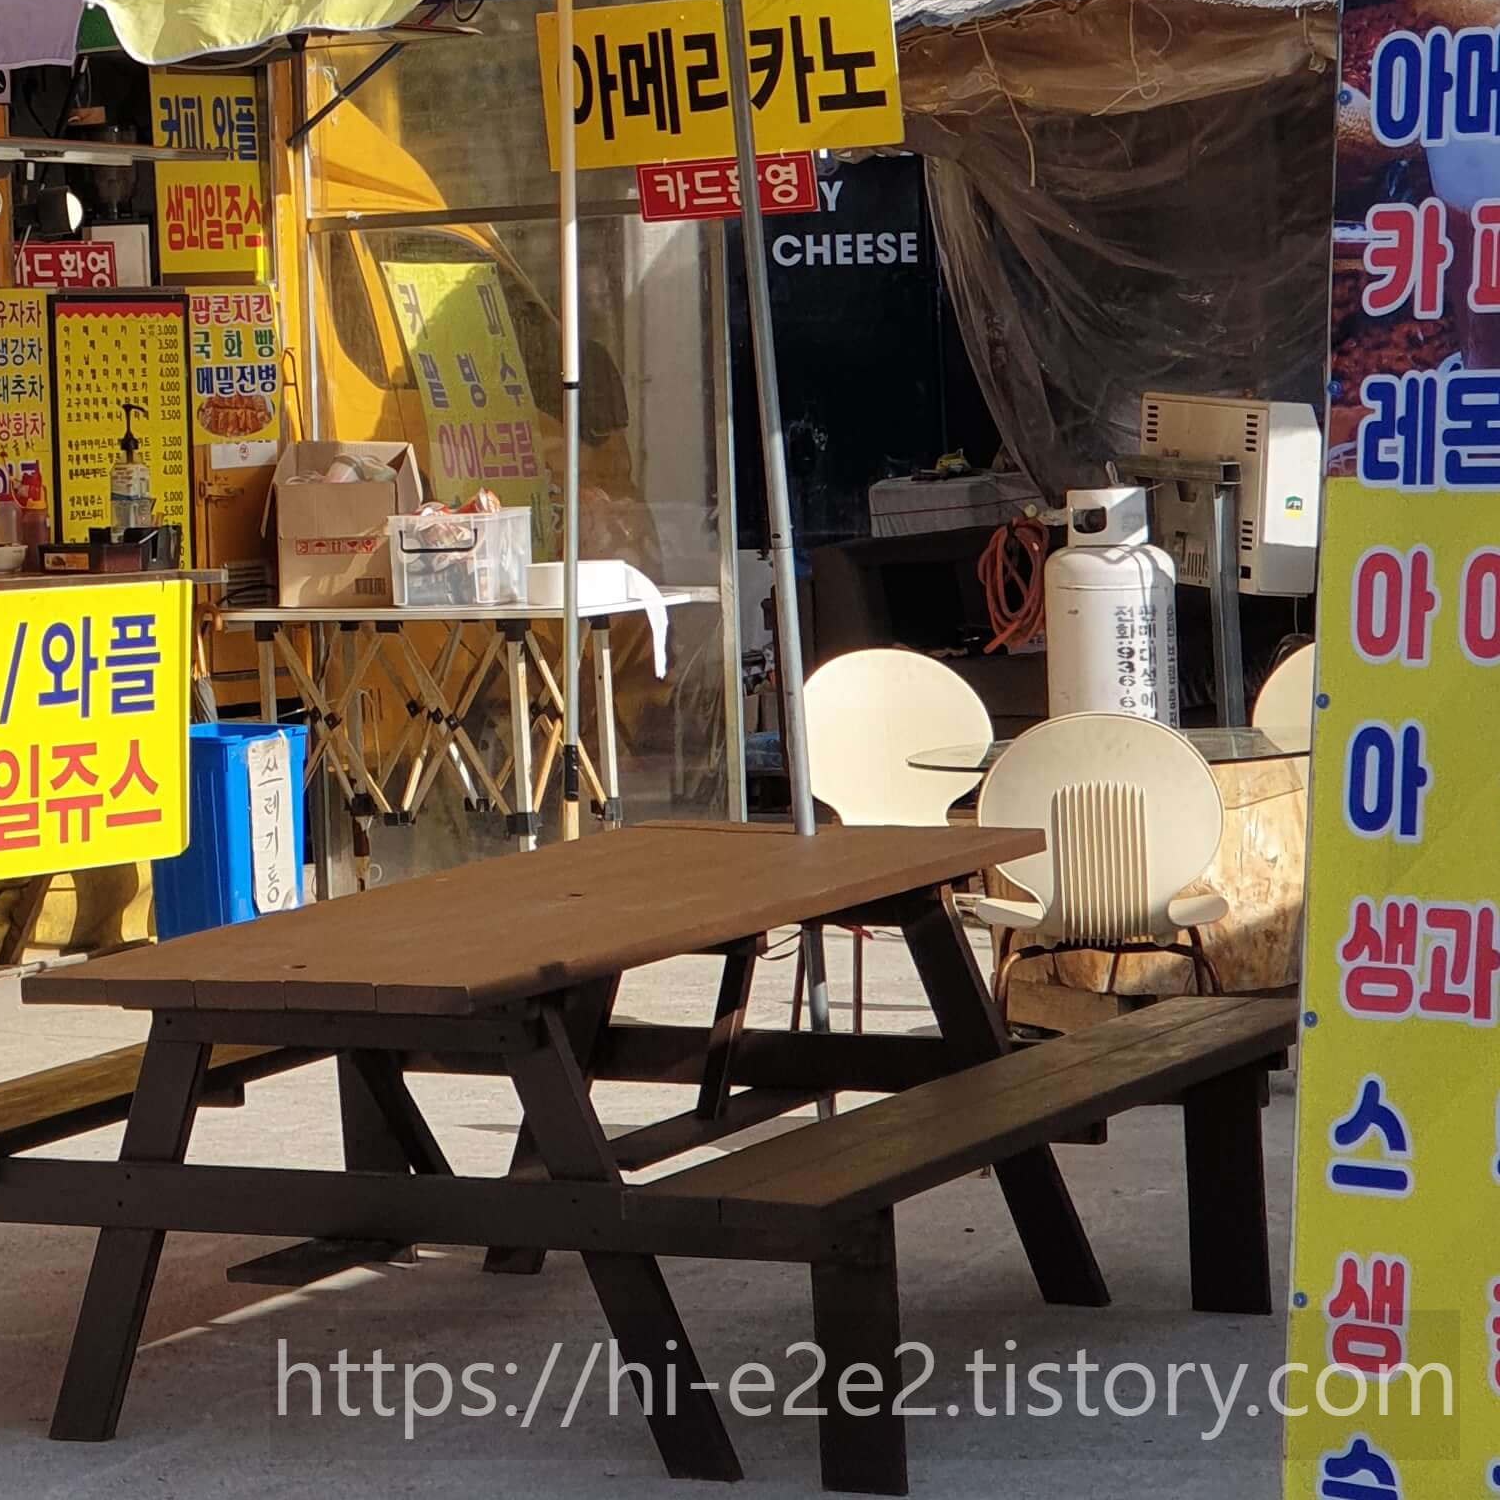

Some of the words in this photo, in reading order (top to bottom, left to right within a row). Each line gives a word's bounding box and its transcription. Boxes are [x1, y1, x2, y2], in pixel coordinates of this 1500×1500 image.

[772, 232, 919, 267] CHEESE
[191, 295, 273, 325] 팝콘치킨
[193, 329, 276, 360] 국화빵
[195, 363, 277, 396] 메밀전병
[258, 756, 284, 904] 쓰레기통
